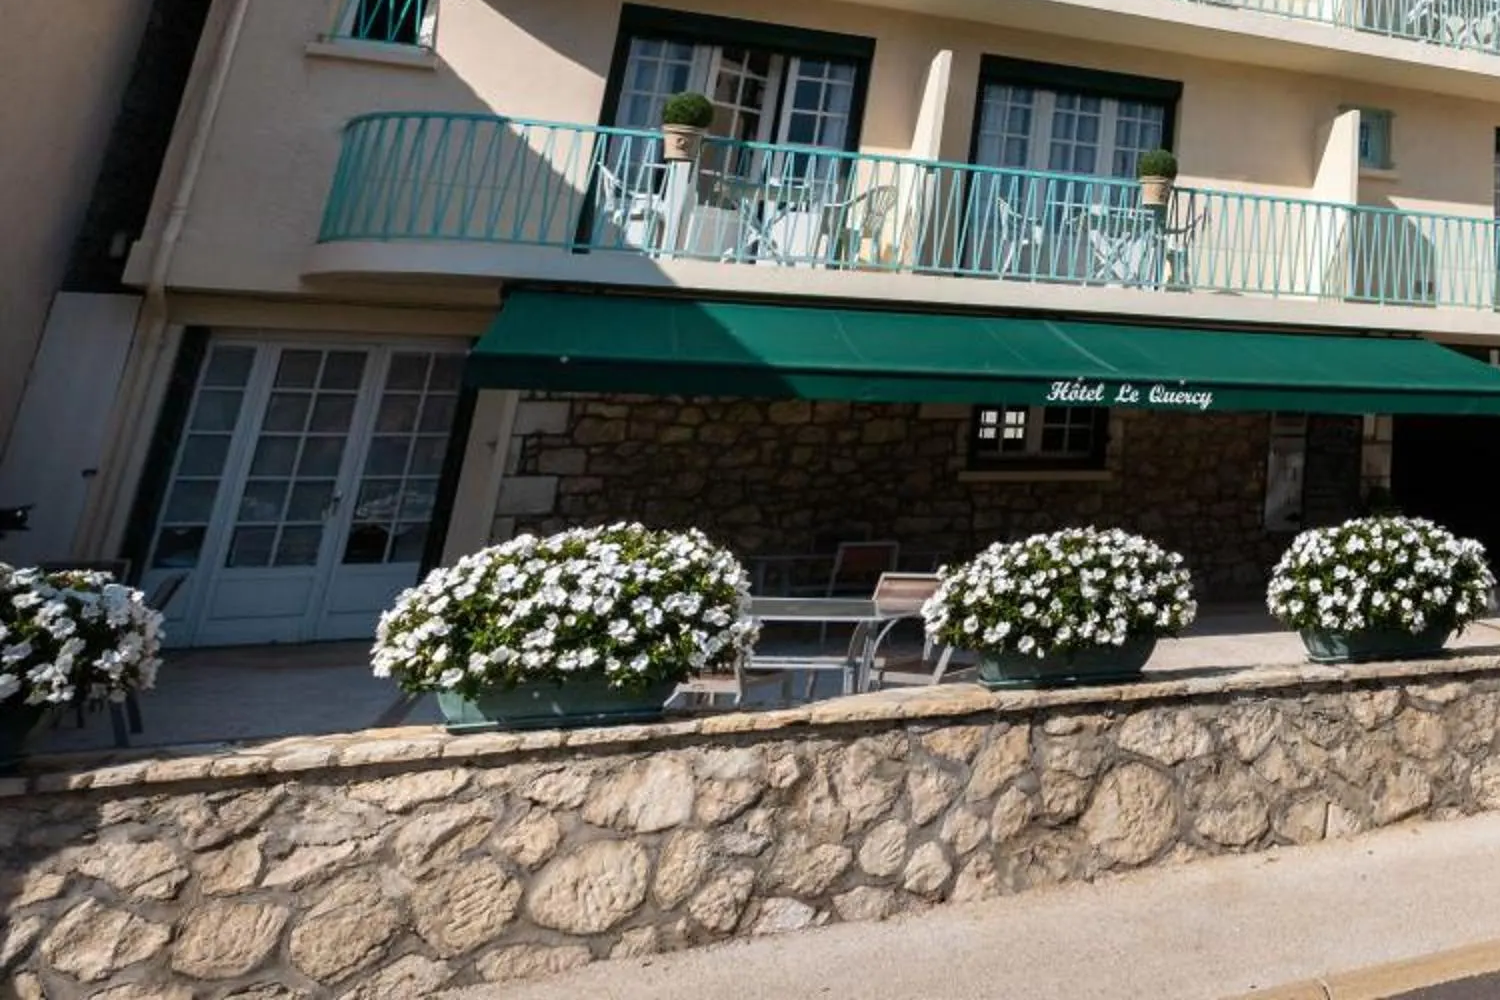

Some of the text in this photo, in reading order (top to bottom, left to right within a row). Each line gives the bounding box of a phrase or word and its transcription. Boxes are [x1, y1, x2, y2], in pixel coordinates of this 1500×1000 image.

[1046, 381, 1213, 410] Hôtel Le Quercy
